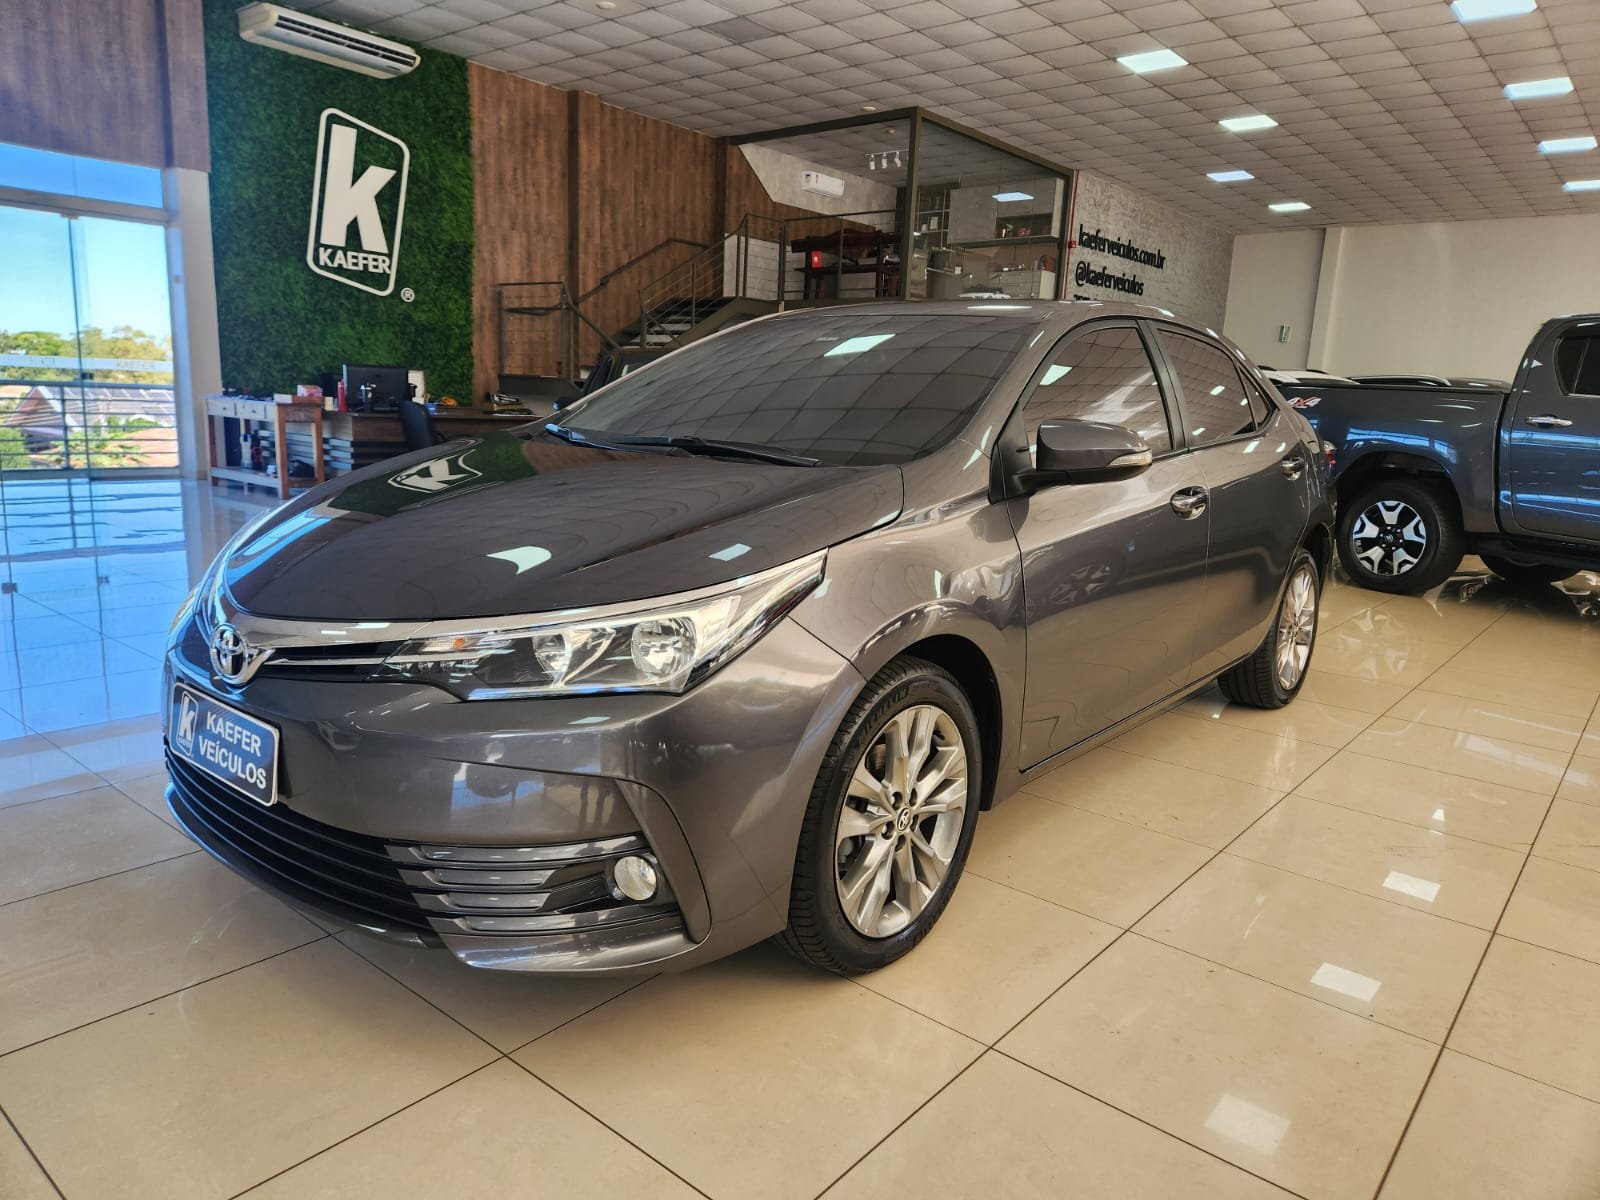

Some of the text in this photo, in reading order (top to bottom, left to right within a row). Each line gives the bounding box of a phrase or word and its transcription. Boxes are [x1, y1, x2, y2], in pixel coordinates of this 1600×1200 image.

[319, 247, 391, 274] KAEFER
[1078, 224, 1166, 270] kaeferveiculos.com.br
[1075, 261, 1144, 296] @kaeferveiculos
[207, 711, 261, 757] KAEFER
[198, 735, 267, 789] VEÍCULOS
